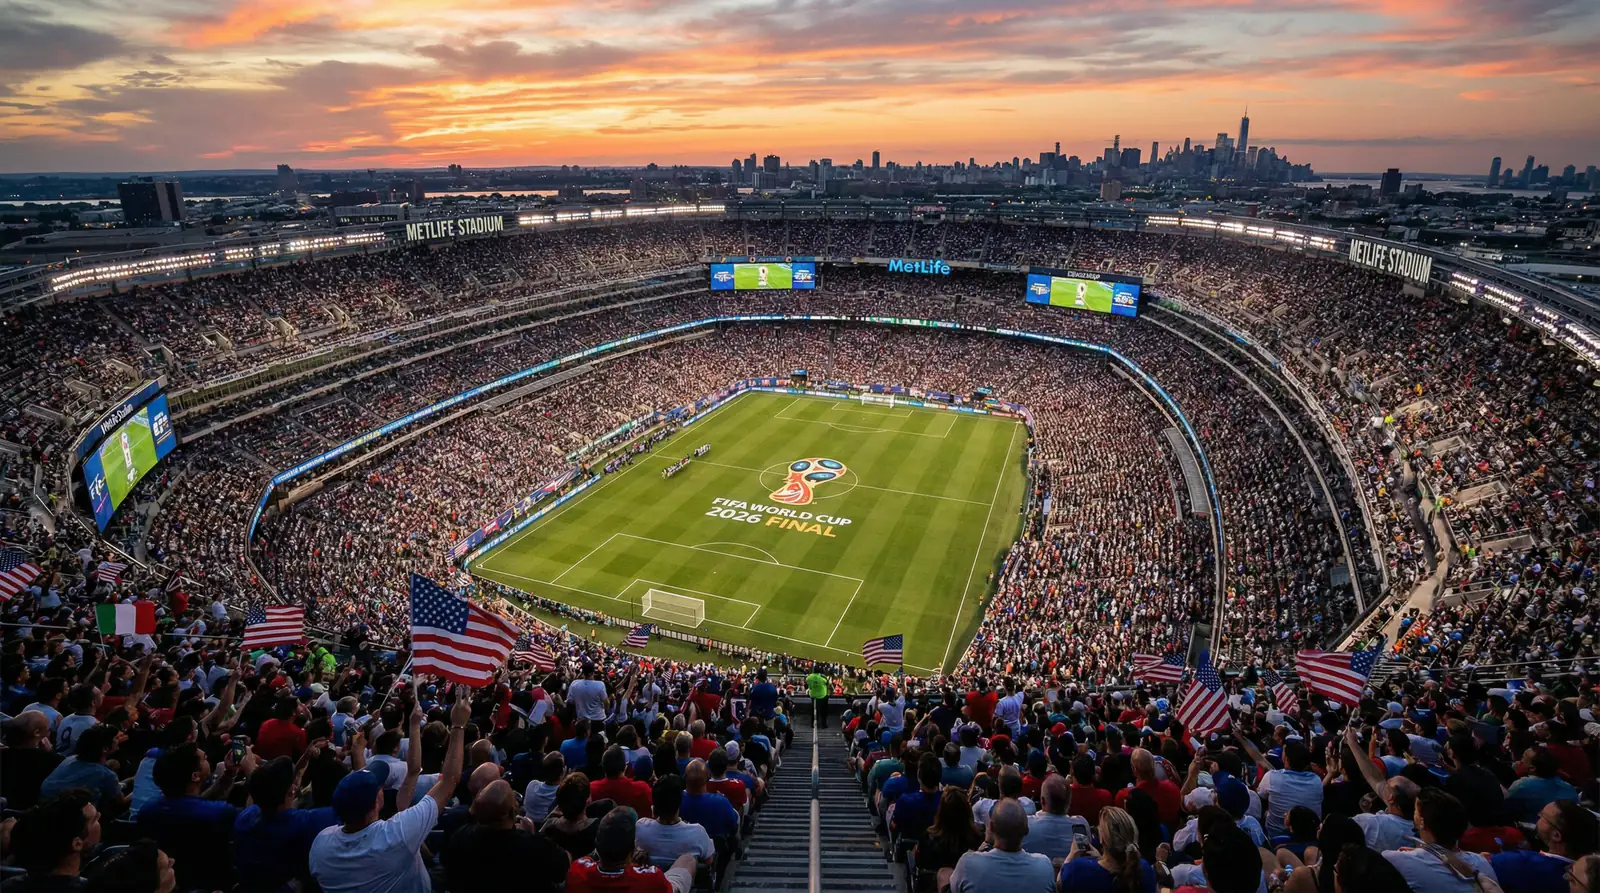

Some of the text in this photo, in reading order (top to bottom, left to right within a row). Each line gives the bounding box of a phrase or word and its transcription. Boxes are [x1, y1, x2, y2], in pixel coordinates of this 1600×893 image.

[406, 216, 503, 241] METLIFE STADIUM
[888, 258, 951, 275] MetLife
[1348, 239, 1432, 283] METLIFE STADIUM
[704, 506, 837, 538] 2026 FINAL
[711, 497, 853, 526] FIFA WORLD CUP
